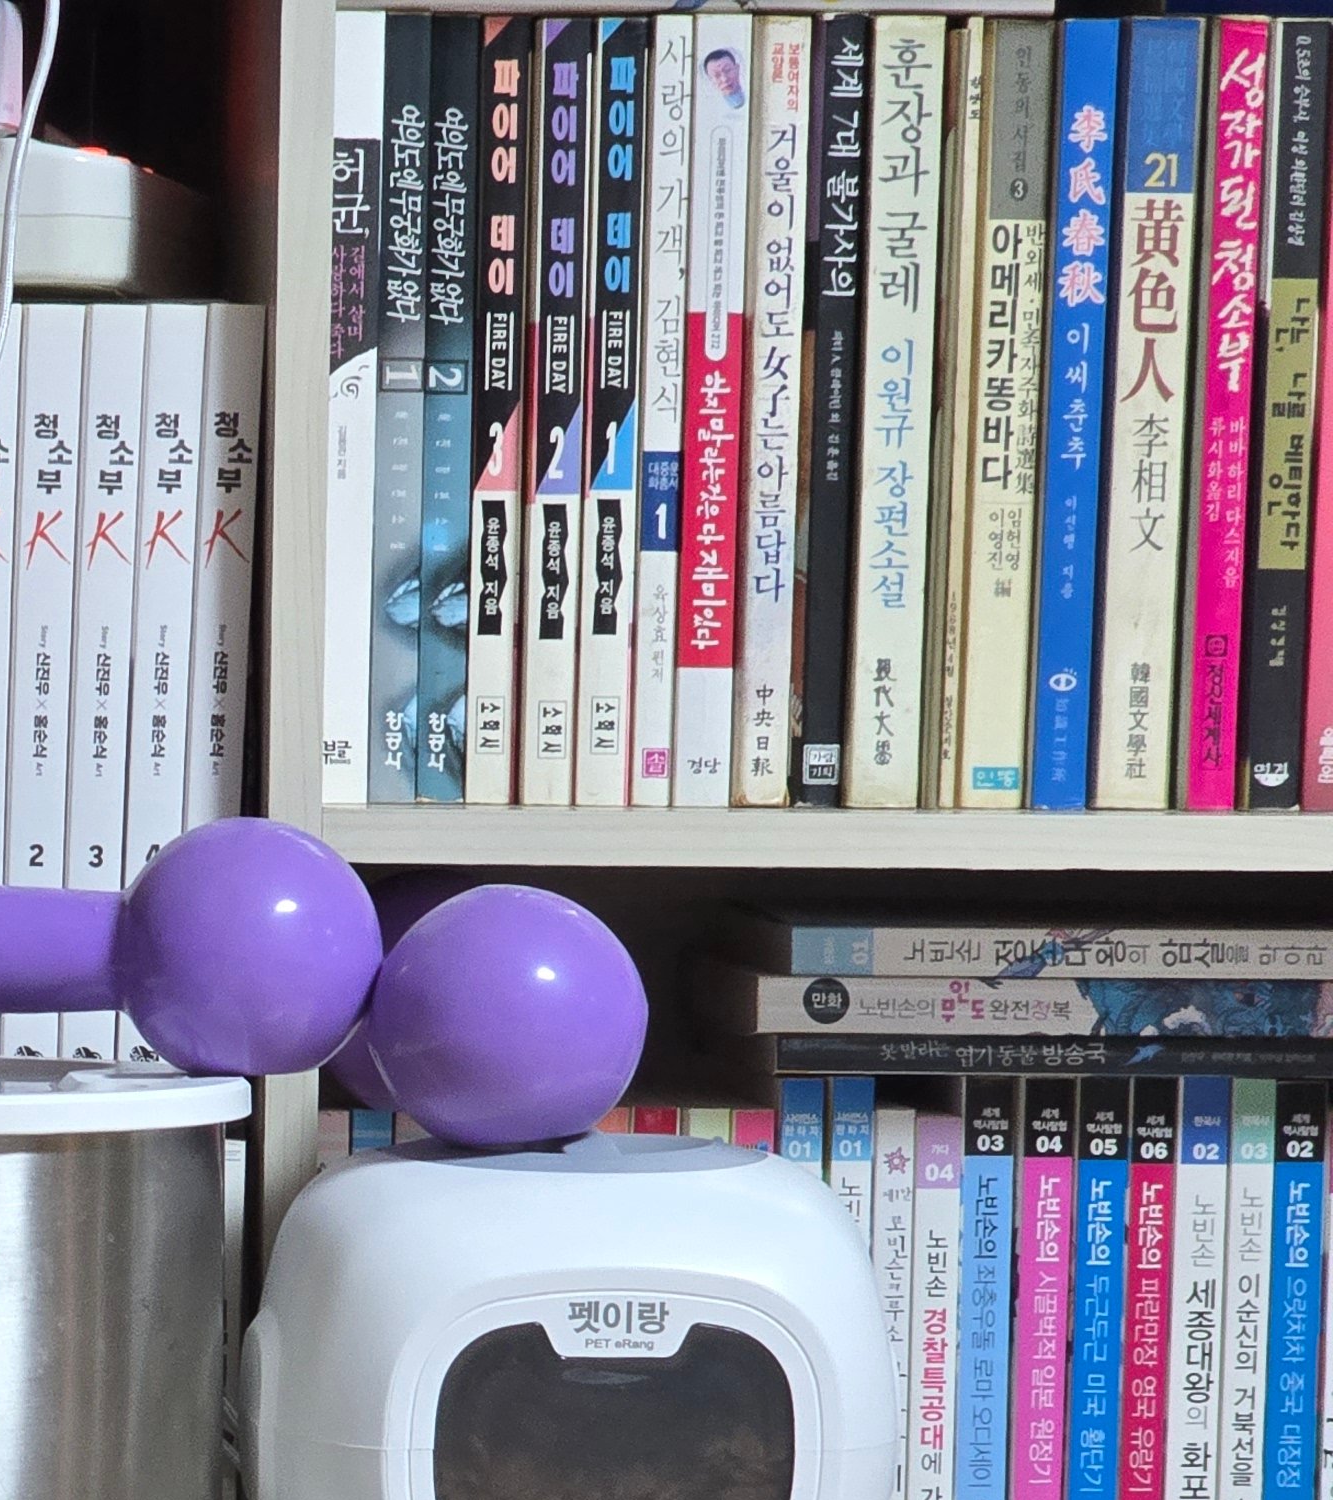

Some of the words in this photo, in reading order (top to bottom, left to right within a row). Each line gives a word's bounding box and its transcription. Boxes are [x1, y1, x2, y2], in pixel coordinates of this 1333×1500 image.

[658, 34, 693, 166] 사랑의
[830, 36, 865, 99] 세계
[489, 58, 521, 184] 파이어
[550, 61, 580, 186] 파이어
[606, 56, 637, 182] 파이어
[827, 110, 861, 158] 7대
[878, 38, 933, 198] 훈장과
[1218, 47, 1267, 170] 성자가
[764, 122, 799, 231] 거울이
[1057, 104, 1109, 308] 李氏春秋
[1142, 152, 1179, 188] 21
[487, 214, 515, 295] 데이
[548, 217, 575, 298] 데이
[603, 211, 632, 293] 데이
[655, 177, 689, 281] 가객,
[821, 169, 860, 297] 불가사의
[876, 211, 928, 314] 굴레
[760, 237, 795, 340] 없어도
[1210, 238, 1257, 393] 청소부
[492, 312, 509, 354] FIRE
[552, 315, 569, 355] FIRE
[648, 295, 683, 424] 김현식
[980, 222, 1024, 490] 아메리카똥바다
[490, 357, 508, 391] DAY
[550, 357, 567, 394] DAY
[873, 338, 916, 449] 이원규
[1060, 321, 1091, 472] 이씨춘추
[33, 412, 73, 494] 청소부
[94, 413, 134, 495] 청소부
[154, 412, 193, 494] 청소부
[213, 411, 253, 493] 청소부
[487, 421, 504, 478] 3
[548, 425, 565, 479] 2
[605, 420, 618, 476] 1
[1128, 412, 1171, 554] 李相文
[23, 510, 71, 571] K
[85, 510, 132, 572] K
[144, 509, 191, 570] K
[203, 508, 251, 568] K
[486, 517, 502, 571] 윤종석
[752, 454, 791, 602] 아름답다
[484, 580, 500, 616] 지음
[35, 651, 51, 696] 신진우
[750, 684, 774, 778] 中央日報
[1124, 661, 1151, 780] 韓國文學社
[687, 757, 722, 775] 경당
[28, 843, 45, 867] 2
[88, 845, 104, 868] 3
[811, 991, 845, 1009] 만화
[857, 998, 938, 1018] 노빈손의
[989, 998, 1072, 1021] 완전정복
[976, 1135, 1006, 1152] 03
[1035, 1136, 1064, 1154] 04
[1089, 1138, 1118, 1156] 05
[1139, 1142, 1169, 1160] 06
[1285, 1140, 1314, 1159] 02
[973, 1174, 1000, 1261] 노빈손의
[1034, 1174, 1062, 1263] 노빈손의
[1084, 1177, 1113, 1266] 노빈손의
[1135, 1181, 1164, 1270] 노빈손의
[1283, 1180, 1312, 1269] 노빈손의
[925, 1229, 949, 1298] 노빈손
[567, 1300, 671, 1336] 펫이랑
[584, 1338, 611, 1350] PET
[614, 1338, 656, 1352] eRang
[1082, 1275, 1110, 1363] 두근두근
[1181, 1278, 1217, 1431] 세종대왕의
[1234, 1272, 1261, 1375] 이순신의
[918, 1307, 950, 1475] 경찰특공대에
[1029, 1364, 1056, 1410] 일본
[1278, 1370, 1304, 1416] 중국
[968, 1407, 994, 1488] 오디세이
[1027, 1417, 1055, 1485] 원정기
[1276, 1423, 1303, 1489] 대장정
